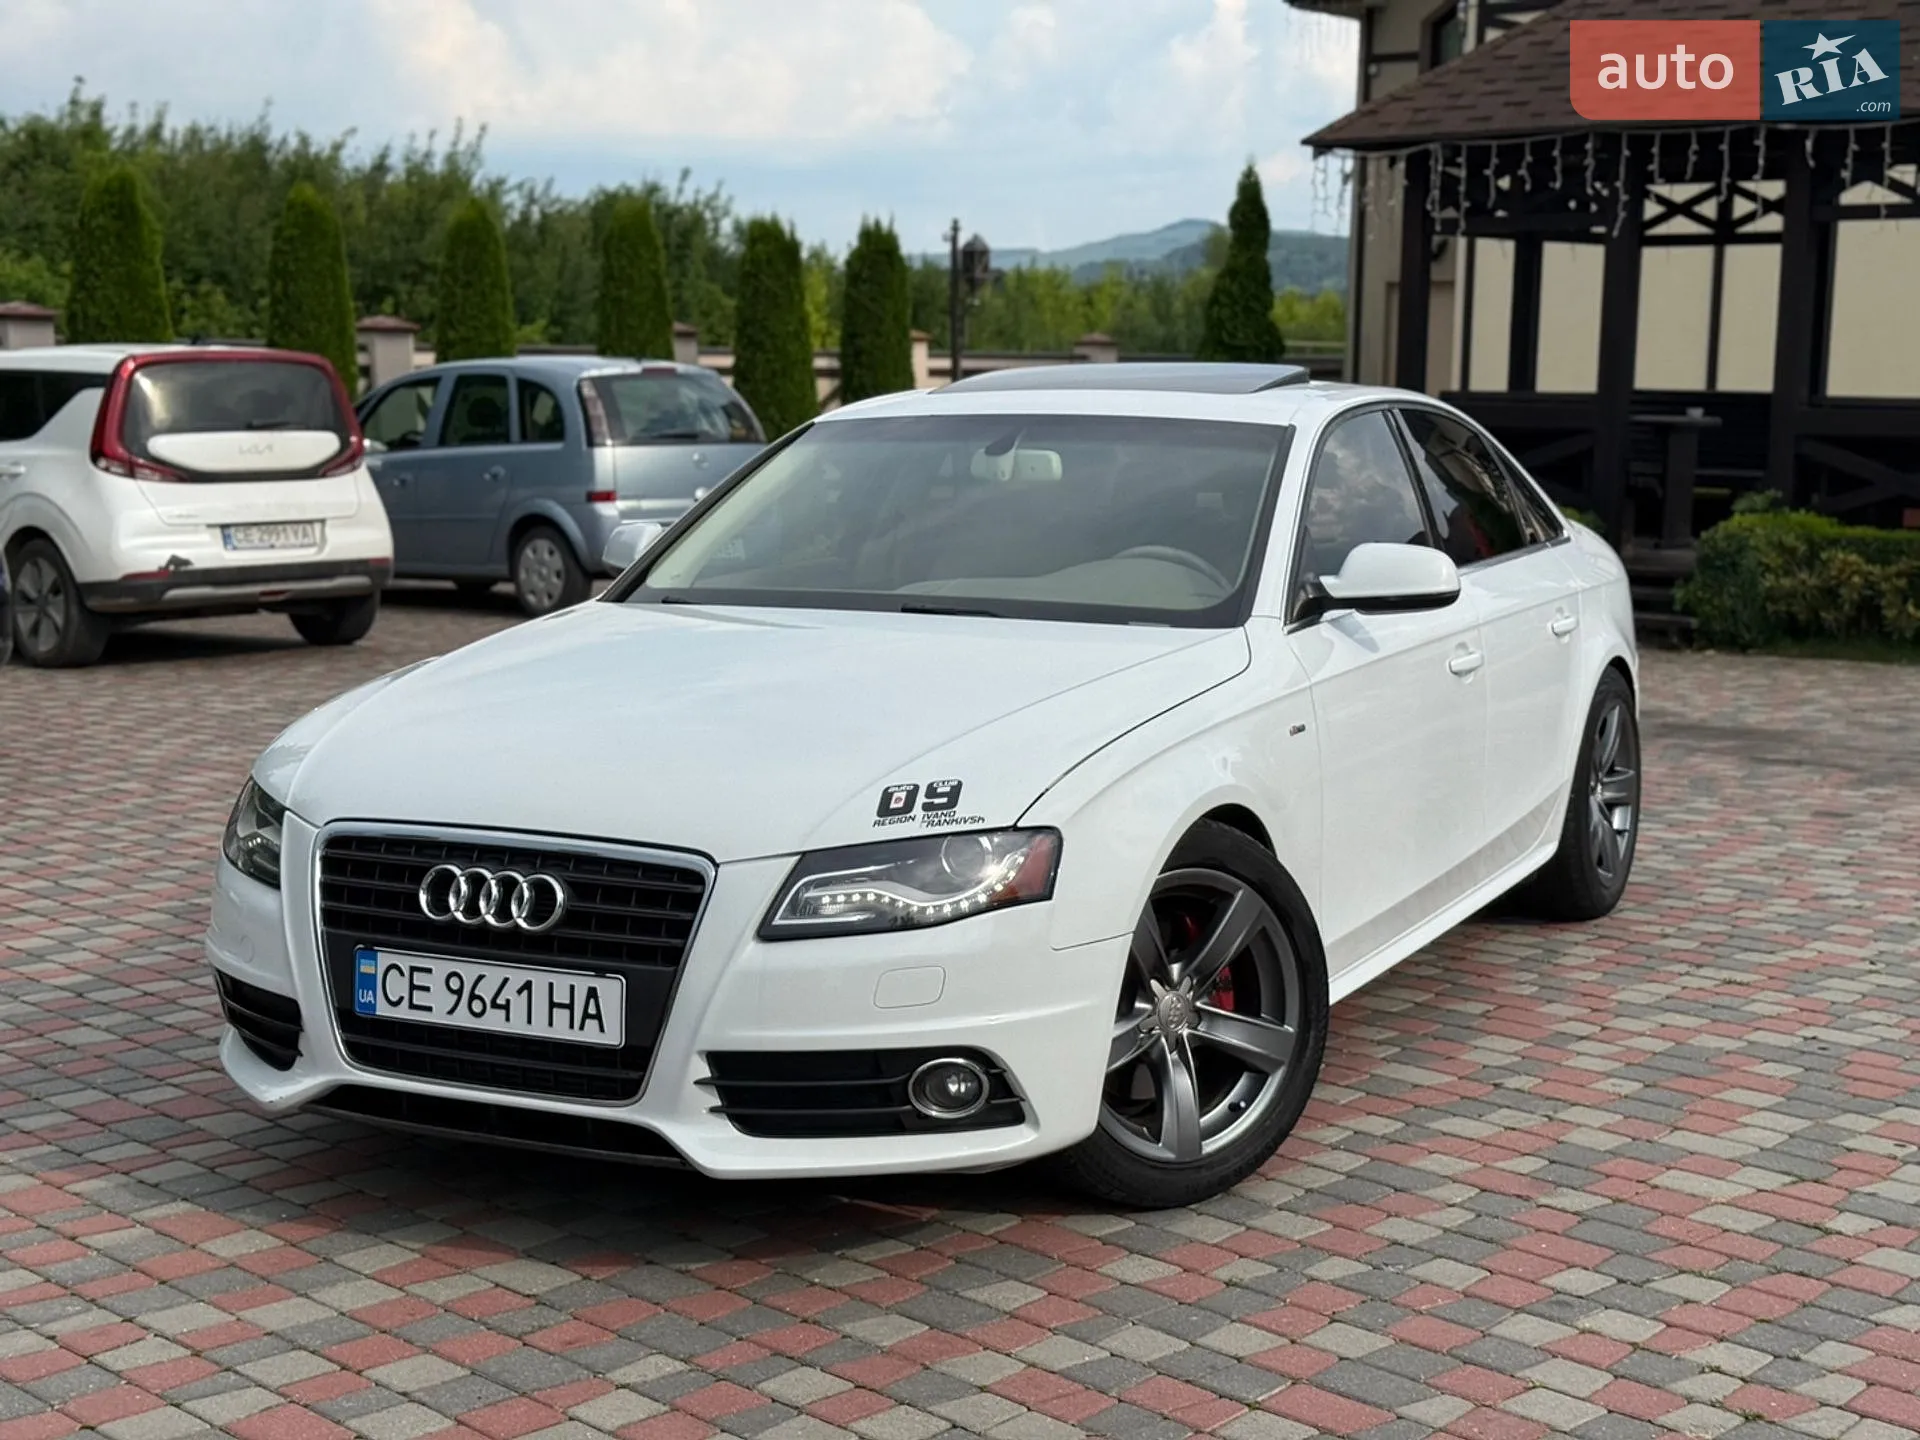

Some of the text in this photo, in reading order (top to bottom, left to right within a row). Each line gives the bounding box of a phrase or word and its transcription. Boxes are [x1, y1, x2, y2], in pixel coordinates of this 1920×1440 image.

[872, 814, 917, 828] REGION
[921, 810, 957, 820] IVANO
[358, 988, 376, 1005] UA
[381, 962, 606, 1034] CE 9641 HA
